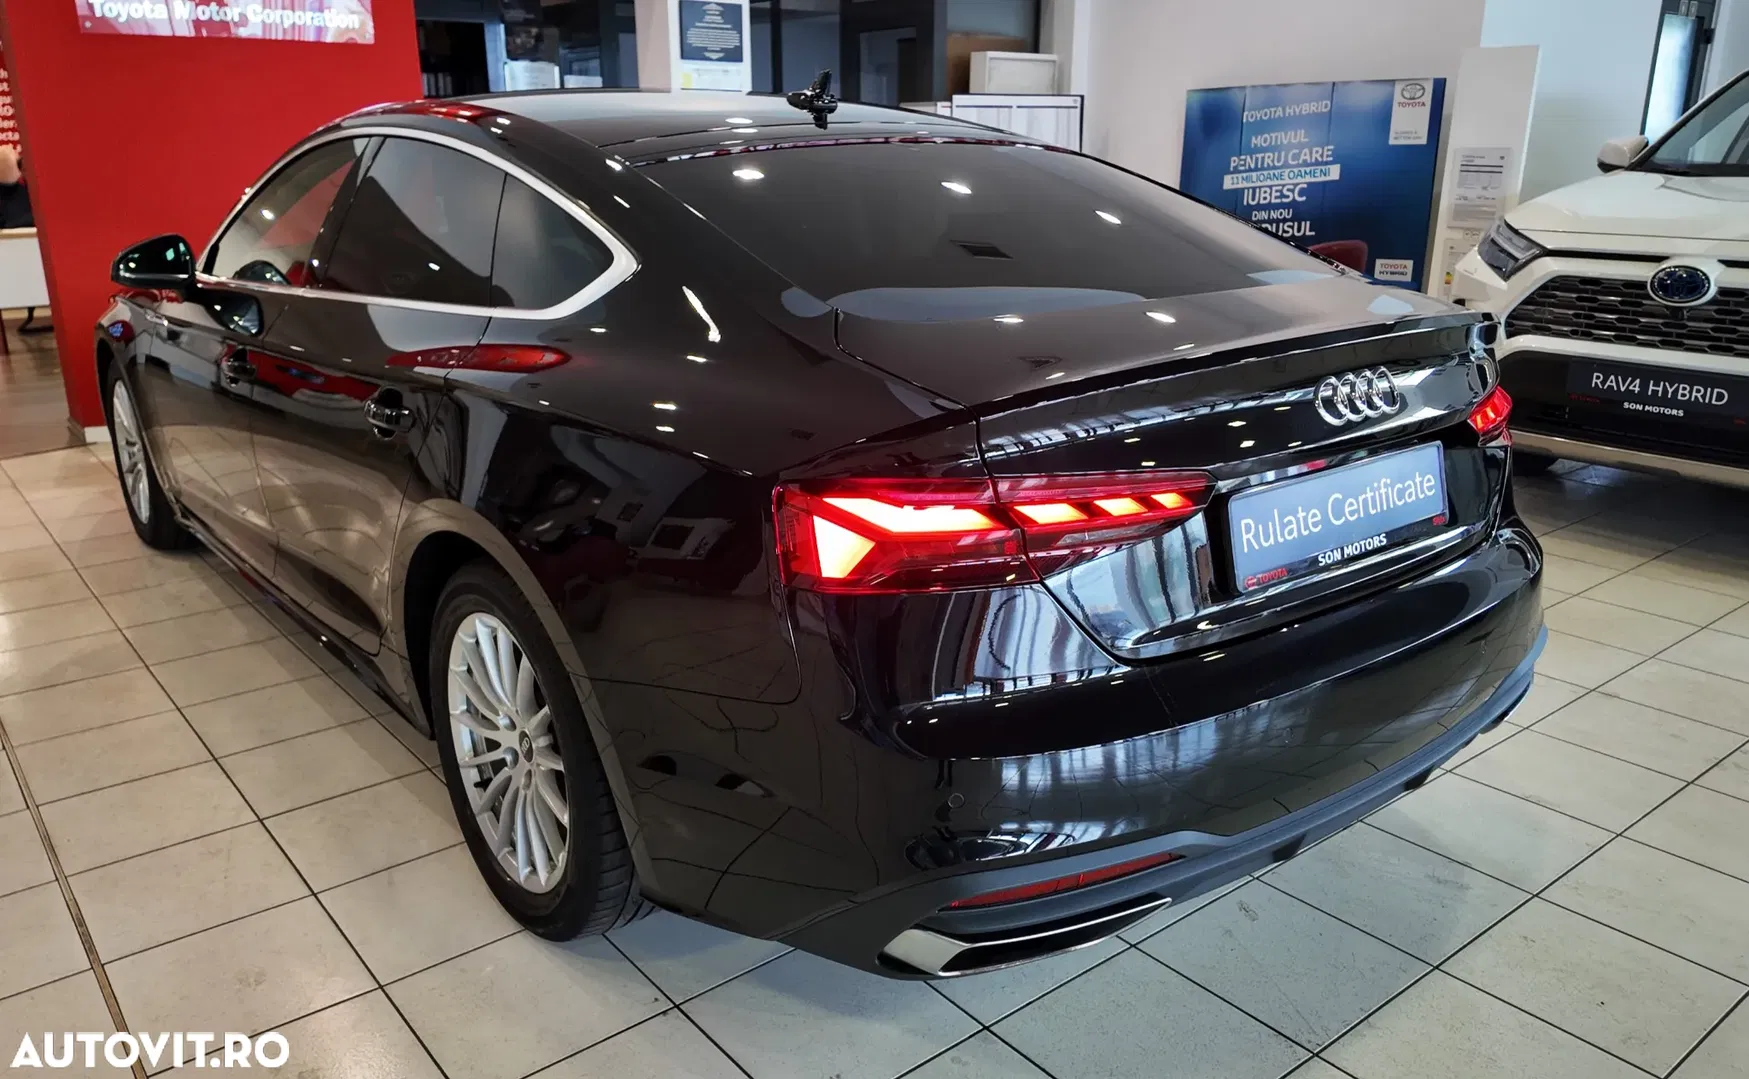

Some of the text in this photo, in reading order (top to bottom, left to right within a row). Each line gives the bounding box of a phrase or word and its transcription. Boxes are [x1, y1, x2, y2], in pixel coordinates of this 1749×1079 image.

[88, 0, 360, 28] Toyota Motor Corporation
[1243, 100, 1331, 123] TOYOTA HYBRID
[1251, 129, 1310, 148] MOTIVUL
[1230, 145, 1334, 171] PENTRU CARE
[1230, 167, 1331, 185] 11 MILIOANE OAMENI
[1243, 183, 1308, 206] IUBESC
[1251, 208, 1293, 221] DIN NOU
[1591, 372, 1729, 406] RAV4 HYBRID
[1623, 401, 1685, 417] SON MOTORS
[1240, 471, 1436, 554] Rulate Certificate
[1317, 533, 1388, 567] SON MOTORS
[1257, 567, 1288, 583] TOYOTA
